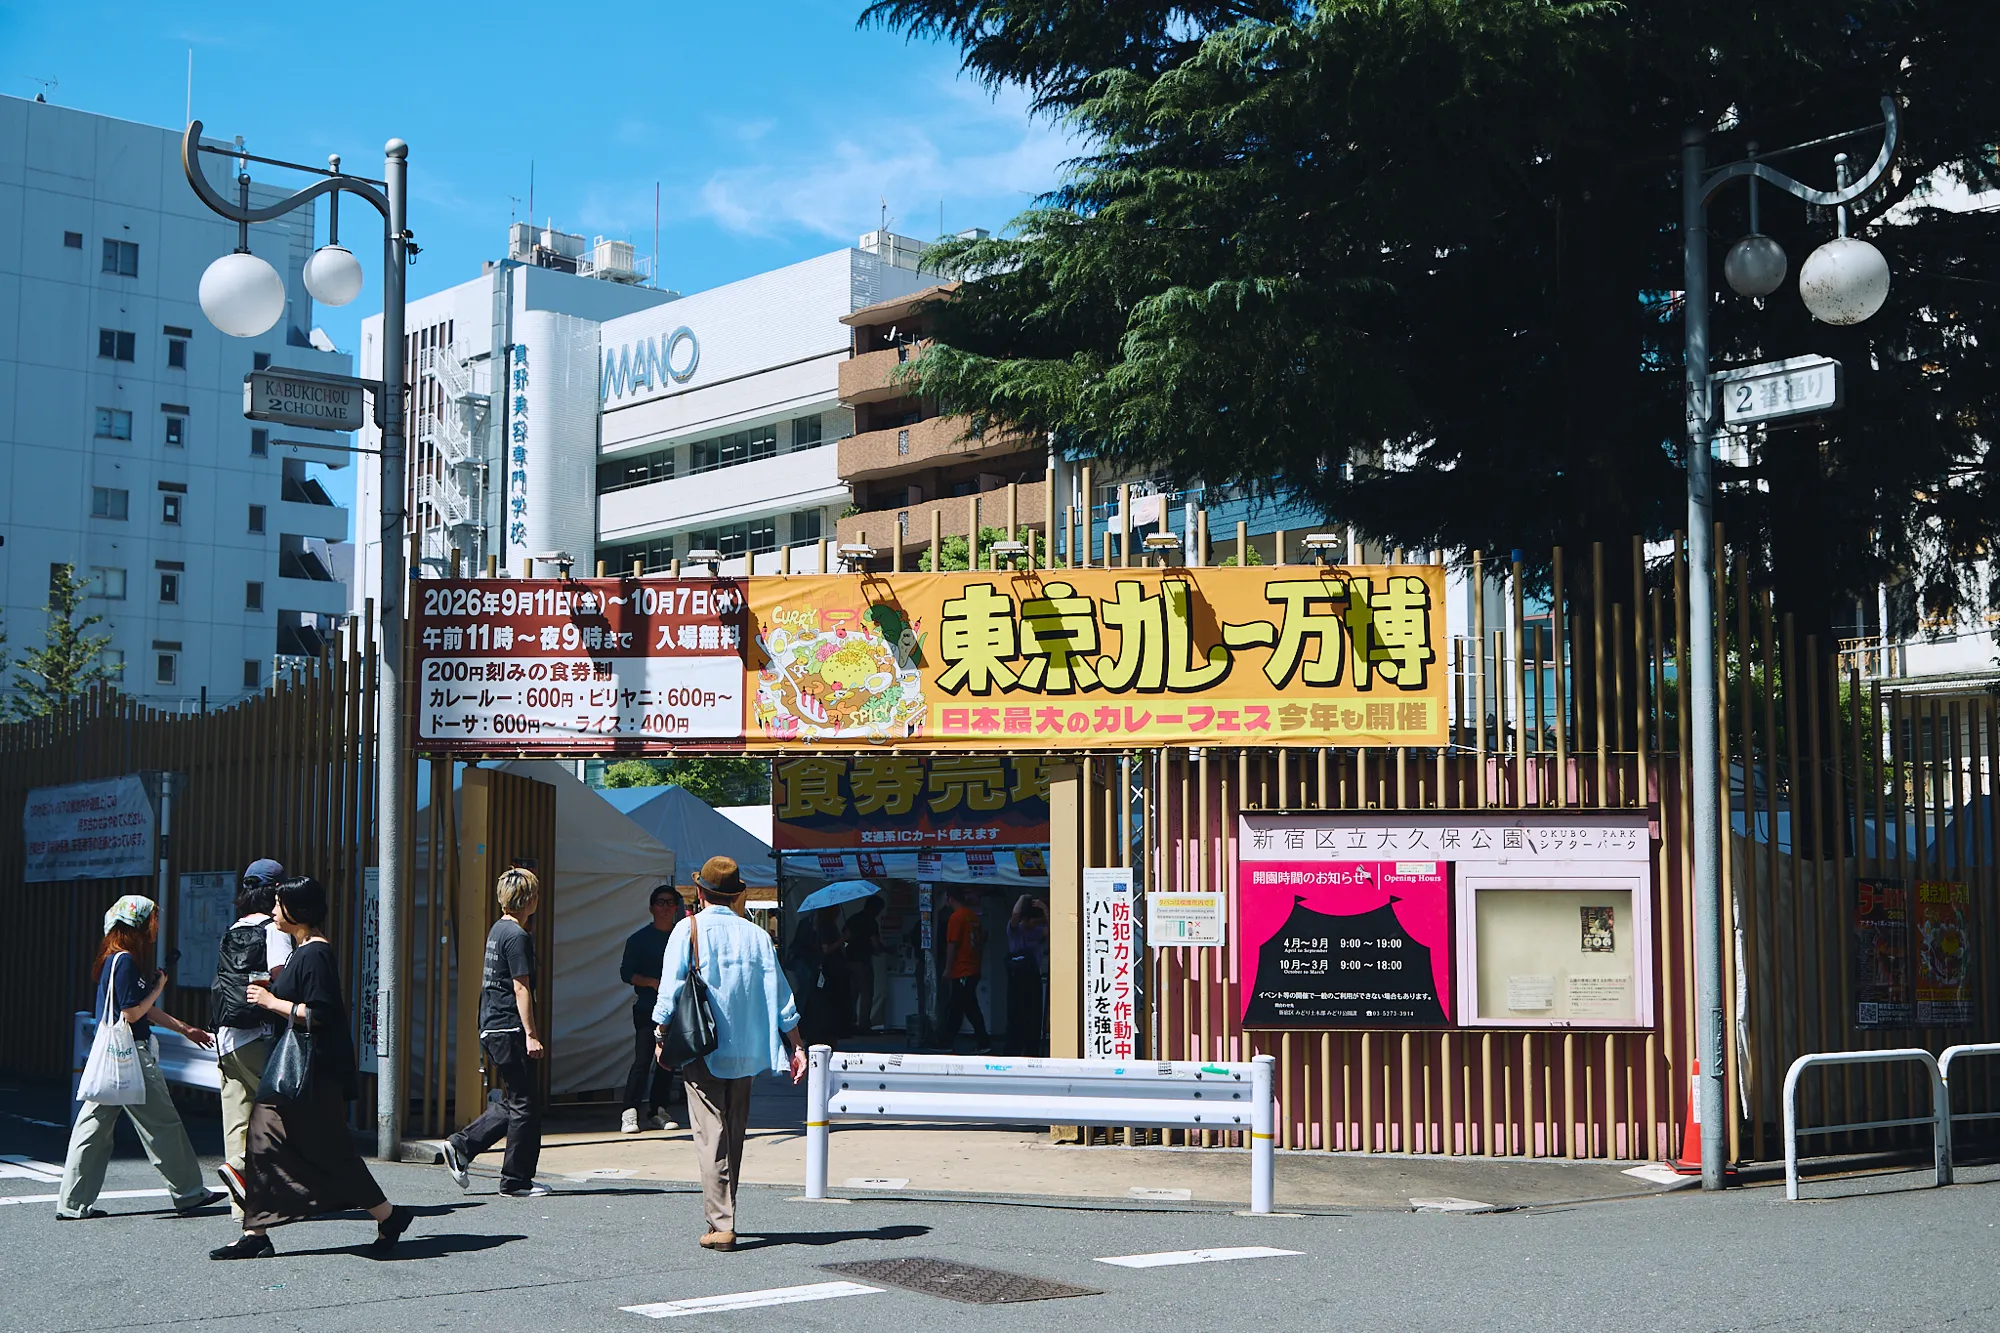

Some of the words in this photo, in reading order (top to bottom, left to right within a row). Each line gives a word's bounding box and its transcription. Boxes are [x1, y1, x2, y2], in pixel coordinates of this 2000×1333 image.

[601, 325, 700, 403] MANO
[1736, 371, 1824, 413] 2番通り
[268, 398, 348, 419] 2CHOUME
[510, 343, 529, 549] 真野美容専門学校
[771, 605, 818, 626] CURRY
[656, 624, 741, 650] 入場無料
[935, 577, 1435, 696] 東京カレー万博
[428, 661, 613, 682] 200円刻みの食券制
[849, 700, 891, 727] SPICY
[942, 705, 1271, 734] 日本最大のカレーフェス
[1277, 702, 1427, 731] 今年も開催
[861, 827, 1000, 843] 交通系ICカード使えます
[1253, 828, 1523, 850] 新宿区立大久保公園
[1540, 829, 1587, 838] OKUBO
[1602, 829, 1636, 838] PARK
[1540, 840, 1636, 850] シアターパーク
[1253, 871, 1364, 885] 開園時間のお知らせ
[1384, 874, 1416, 883] Opening
[1419, 874, 1441, 882] Hours
[1340, 938, 1361, 948] 9:00
[1376, 938, 1402, 948] 19:00
[1340, 960, 1361, 970] 9:00
[1376, 960, 1402, 970] 18:00
[1112, 902, 1132, 1060] 防犯カメラ作動中
